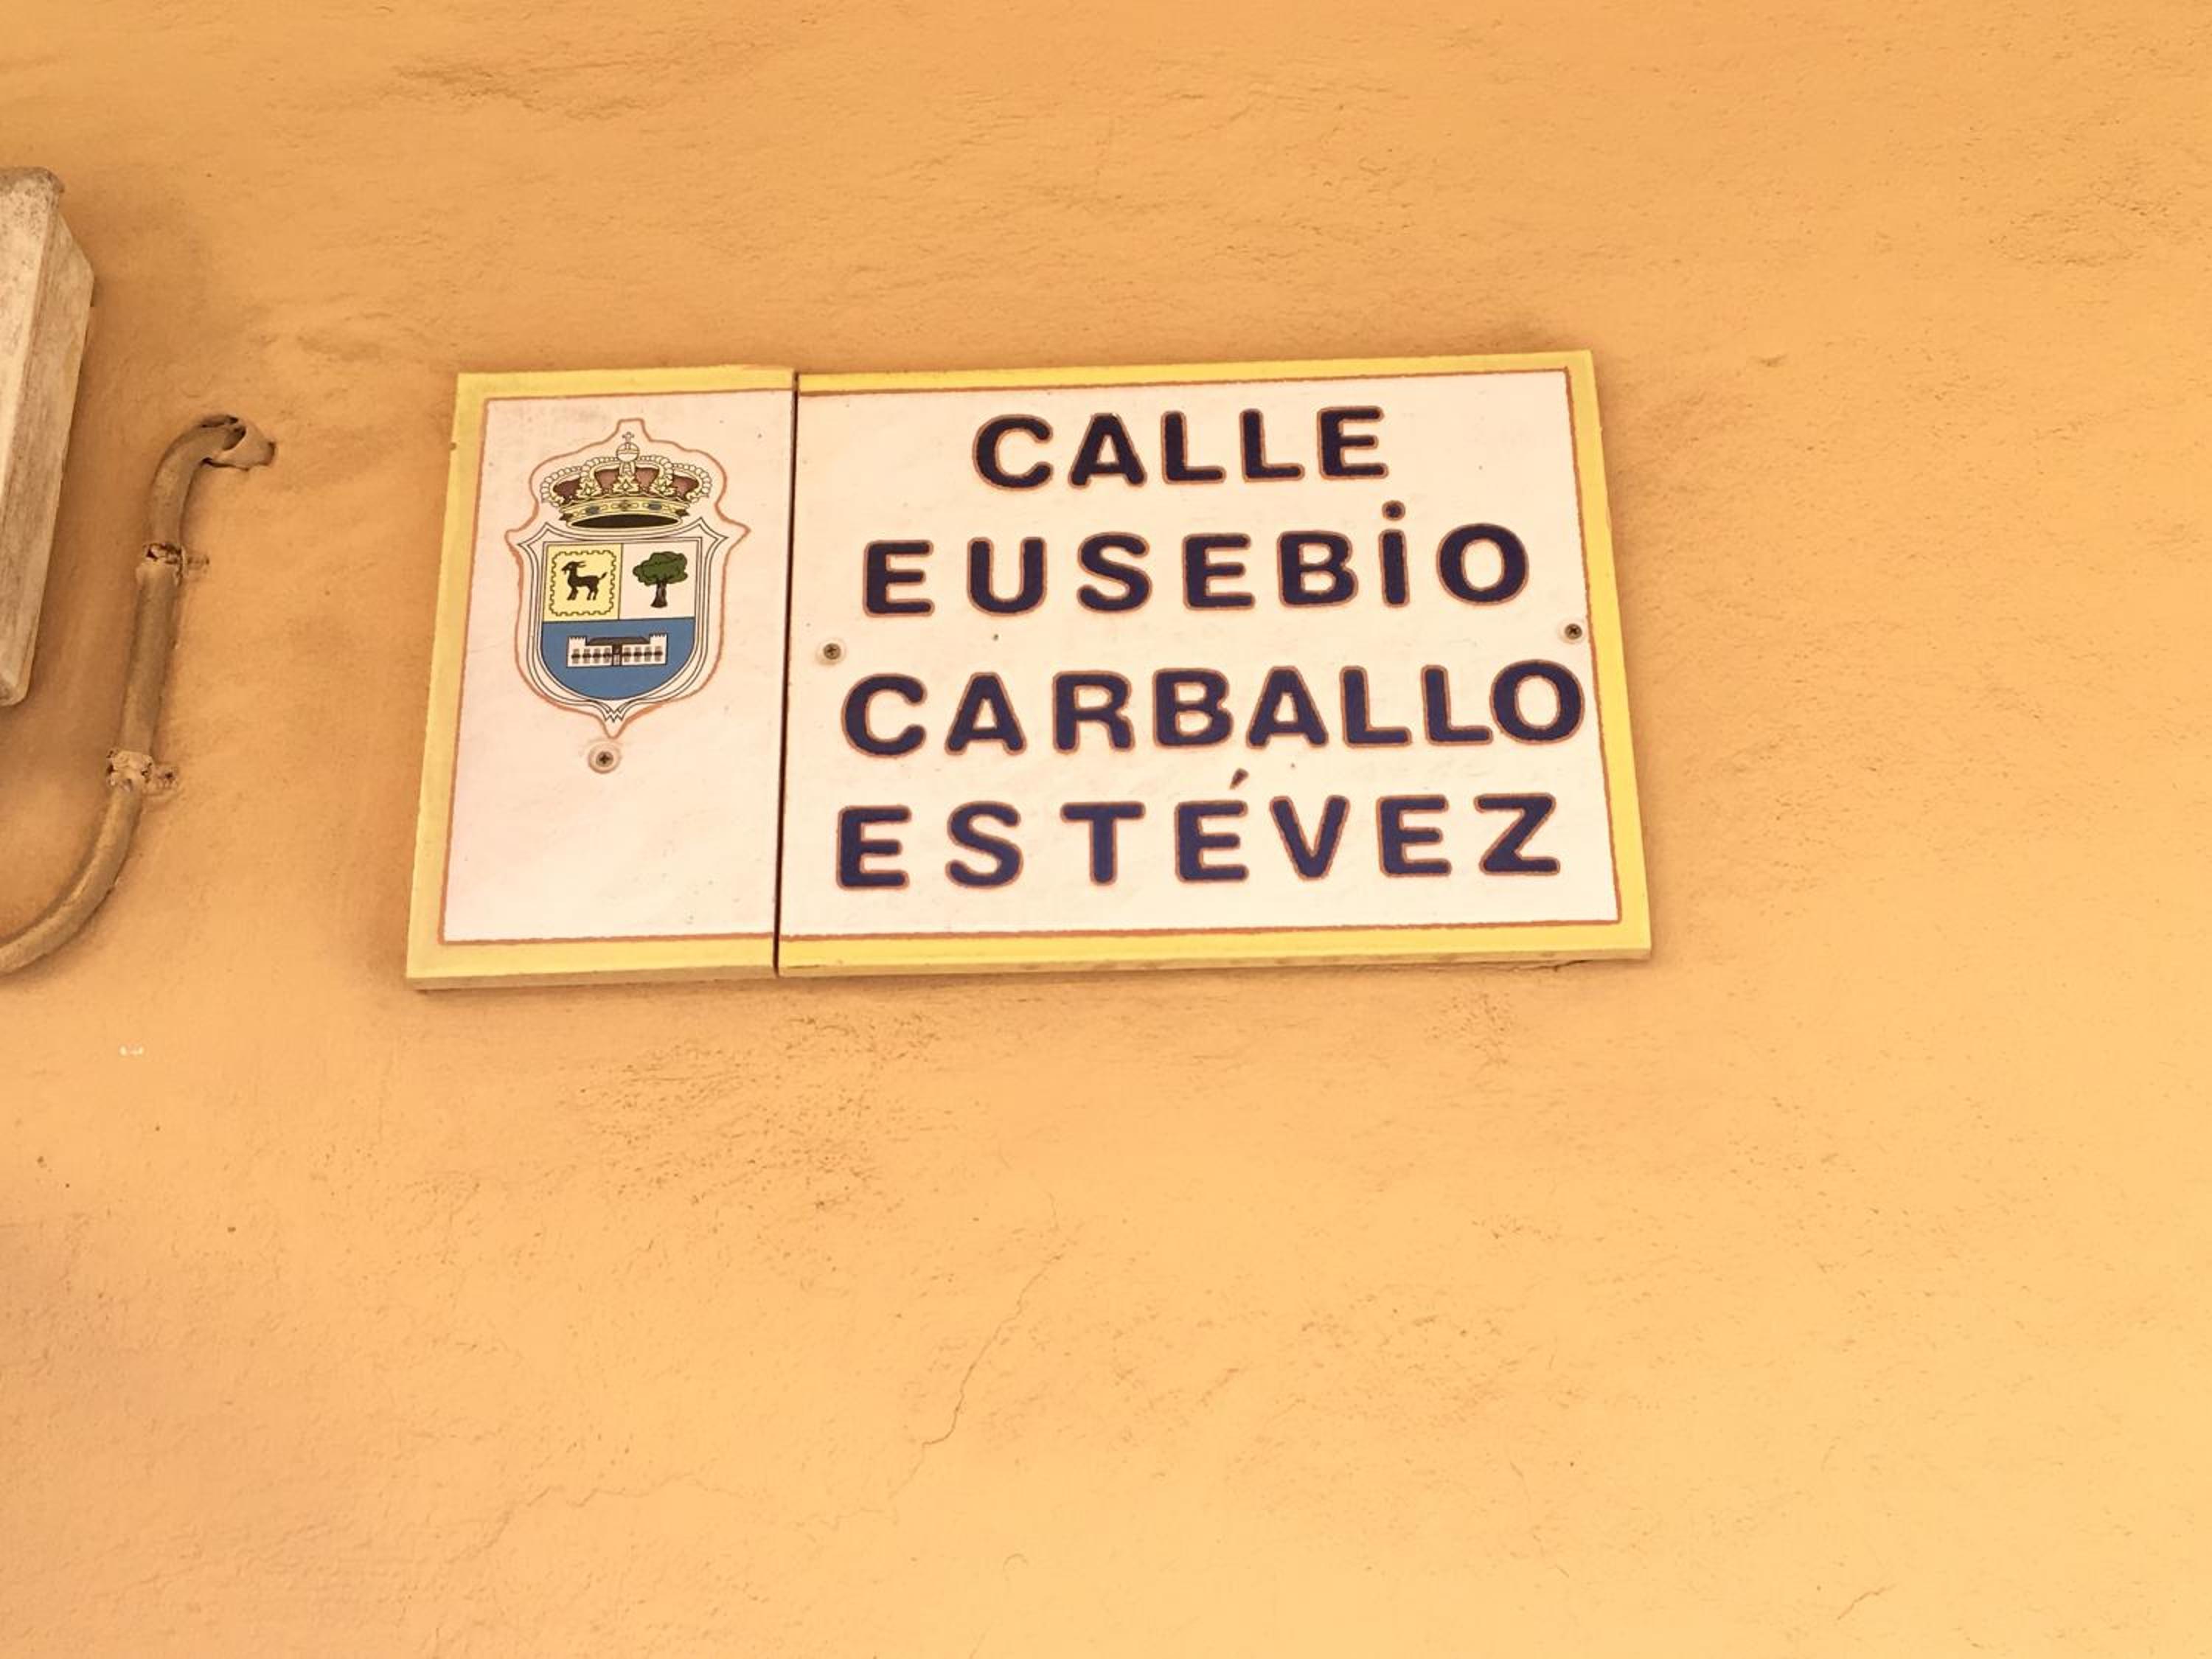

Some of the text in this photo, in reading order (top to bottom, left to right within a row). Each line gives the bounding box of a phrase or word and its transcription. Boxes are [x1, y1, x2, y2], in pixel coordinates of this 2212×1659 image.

[974, 407, 1388, 490] CALLE
[843, 660, 1584, 757] CARBALLO
[837, 769, 1559, 888] ESTÉVEZ
